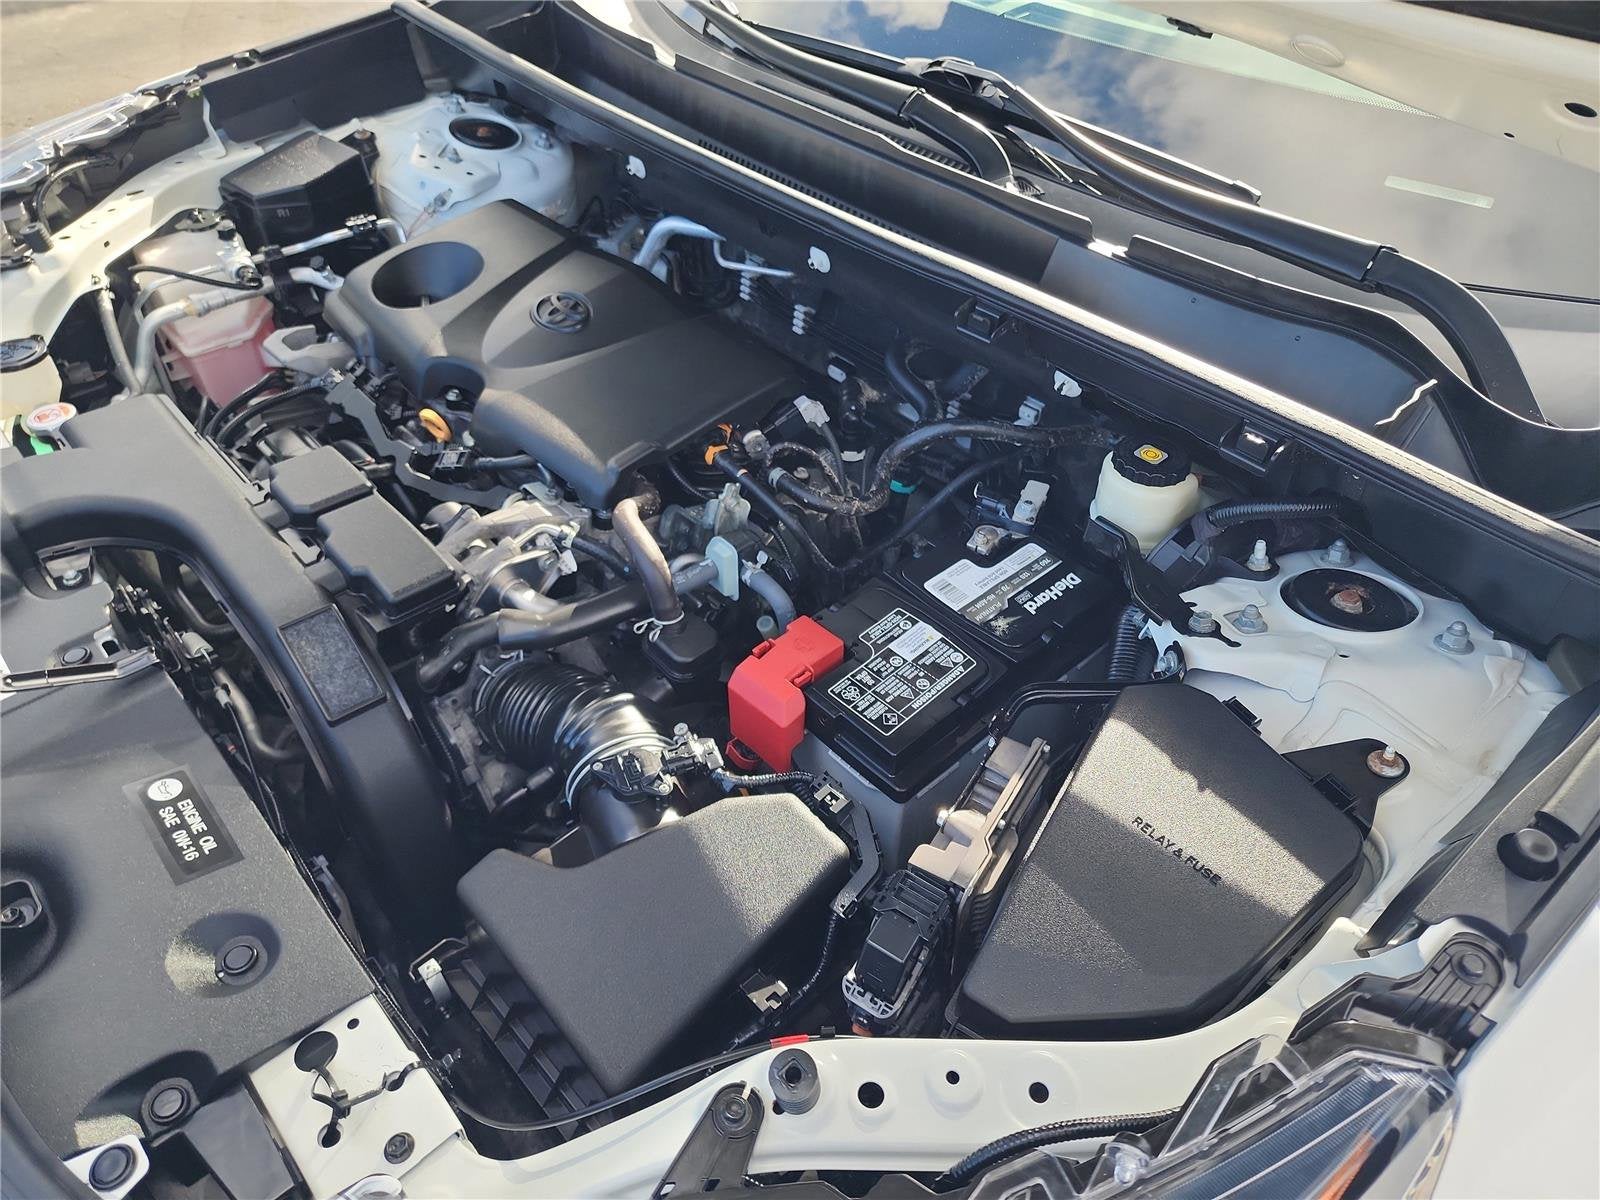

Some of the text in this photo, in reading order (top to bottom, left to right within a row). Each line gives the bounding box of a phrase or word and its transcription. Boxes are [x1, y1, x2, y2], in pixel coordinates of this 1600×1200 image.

[973, 601, 1002, 621] PLATINUM
[1022, 572, 1082, 614] DieHard
[910, 669, 961, 709] DANGER/POISON
[158, 806, 200, 862] SAE 0W-16
[177, 798, 218, 856] ENGINE OIL
[1132, 816, 1222, 887] RELAY & FUSE
